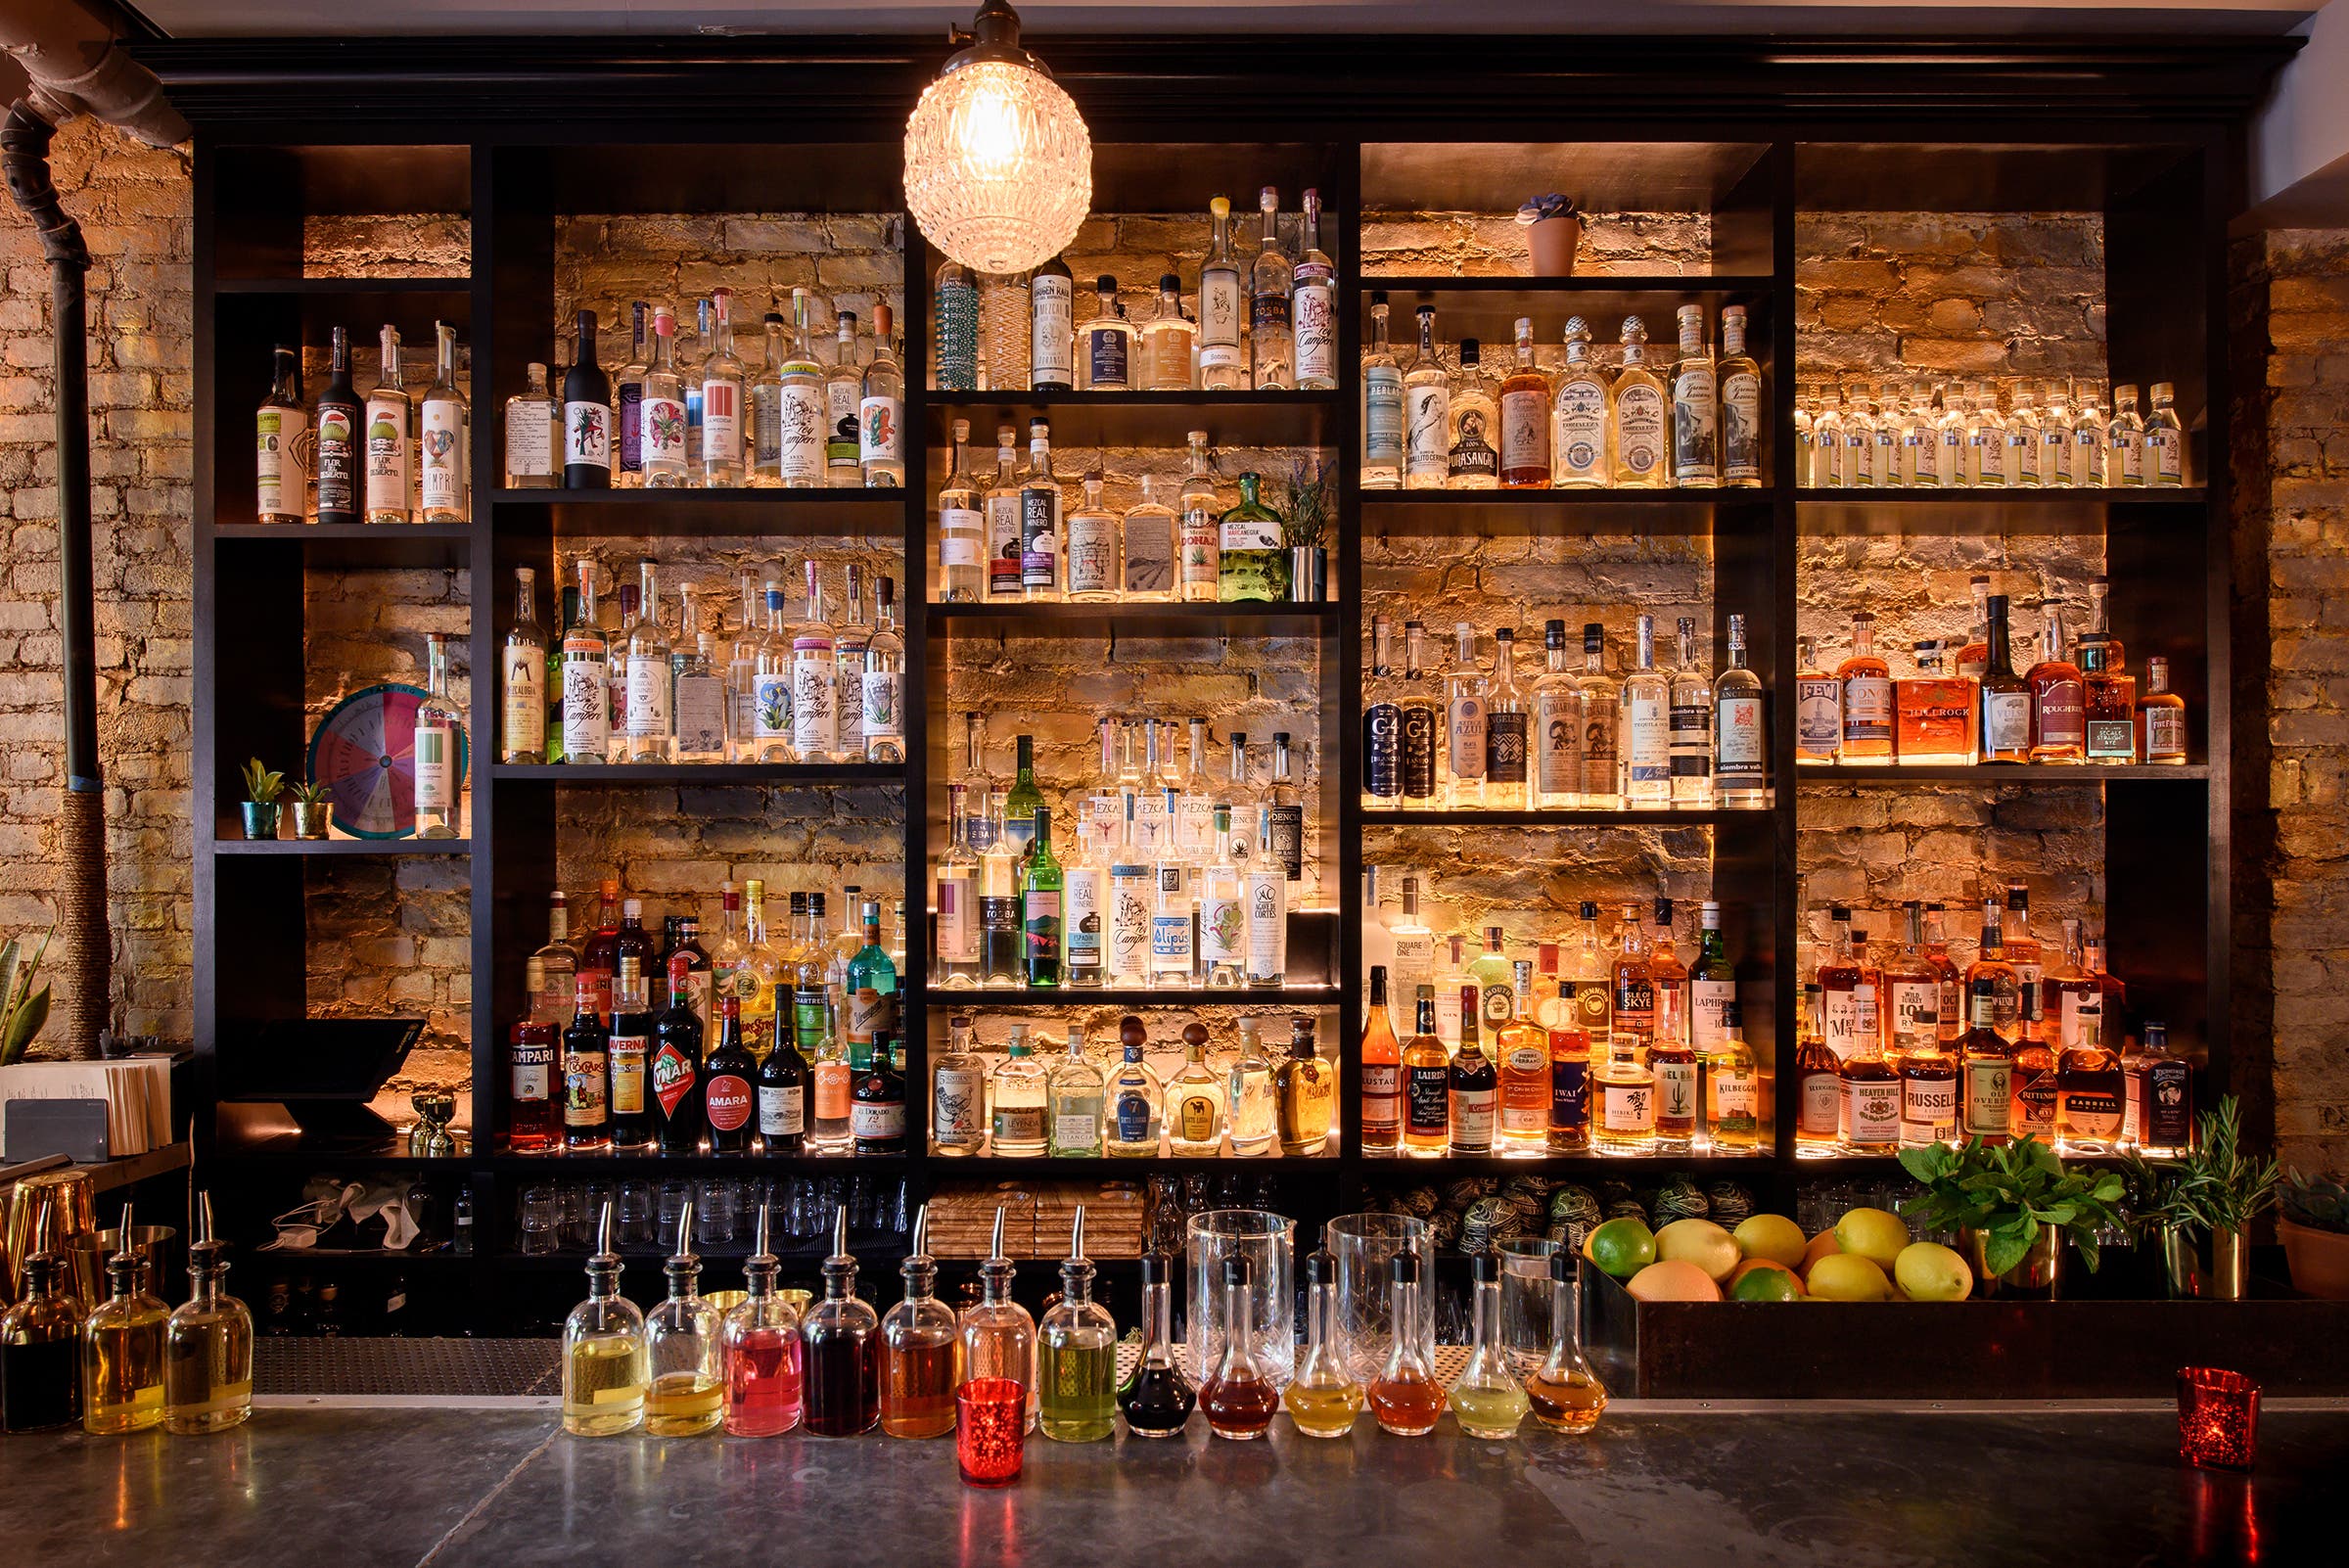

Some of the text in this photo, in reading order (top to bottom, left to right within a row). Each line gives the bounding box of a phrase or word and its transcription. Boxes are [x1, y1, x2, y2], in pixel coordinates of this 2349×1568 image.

[833, 394, 852, 405] REAL
[1027, 507, 1048, 518] REAL
[994, 515, 1016, 526] REAL
[1802, 684, 1836, 698] FEW
[1910, 708, 1970, 717] HILLROCK
[2042, 705, 2071, 715] ROUGH
[1371, 716, 1400, 736] G4
[1405, 720, 1432, 738] G4
[1073, 888, 1093, 899] REAL
[1153, 926, 1189, 946] Alipús
[1397, 941, 1423, 949] SQUARE
[1624, 998, 1651, 1008] SKYE
[610, 1038, 648, 1050] AVERNA
[653, 1058, 692, 1093] CYNAR
[1859, 1087, 1899, 1097] HEAVEN HILL
[709, 1095, 748, 1106] AMARA
[2070, 1099, 2117, 1108] BARRELL
[1130, 1100, 1139, 1113] 7
[1936, 1128, 1944, 1139] 6
